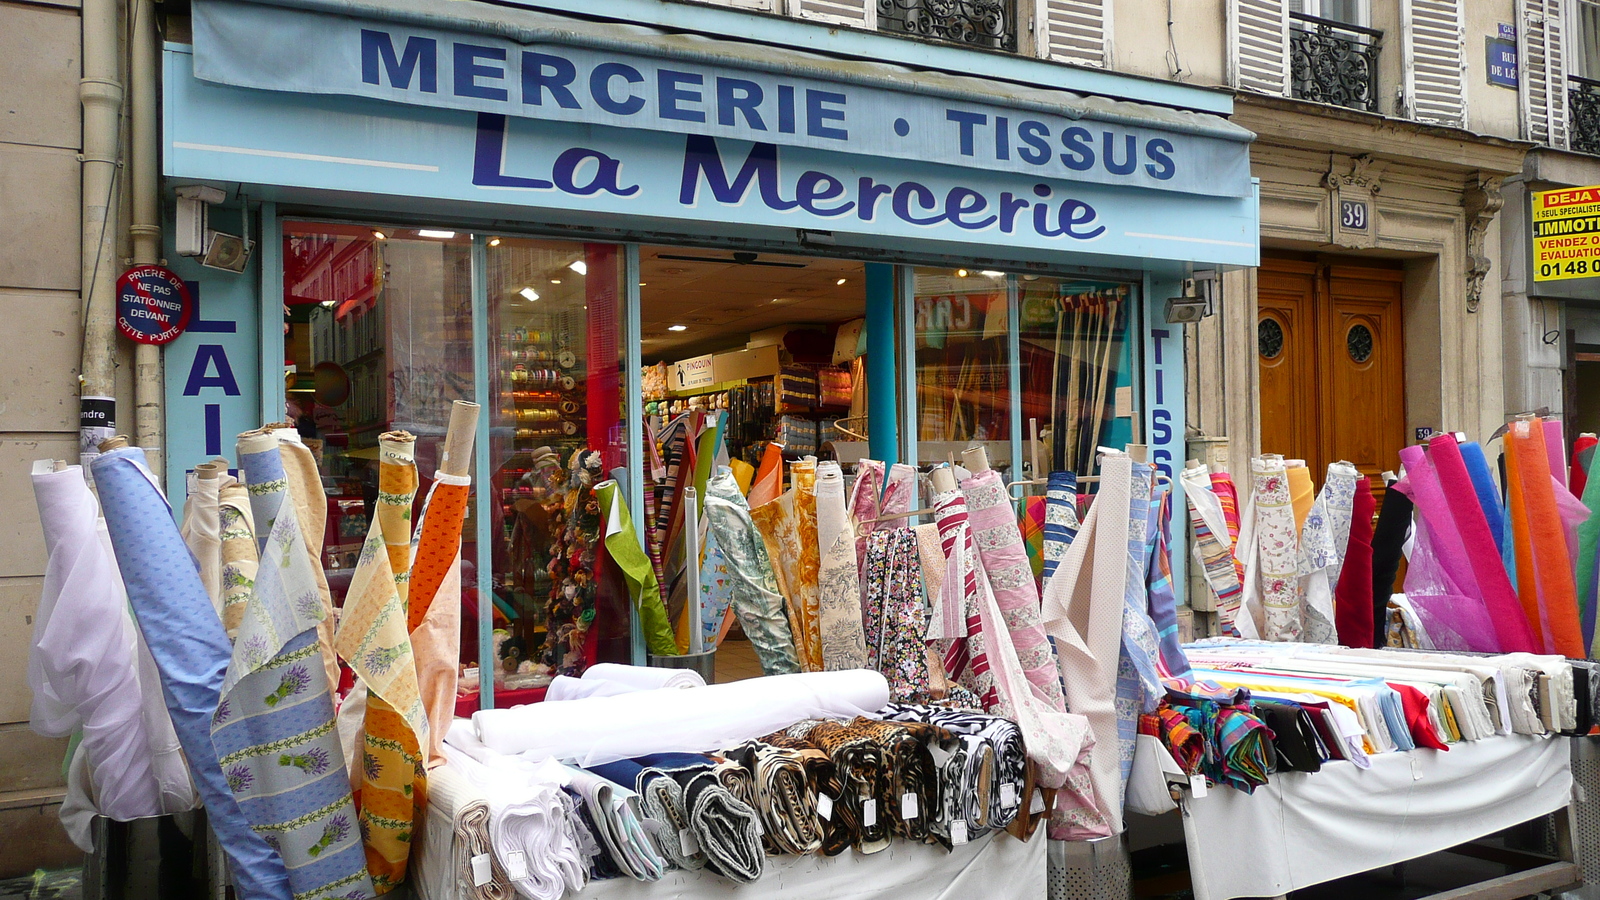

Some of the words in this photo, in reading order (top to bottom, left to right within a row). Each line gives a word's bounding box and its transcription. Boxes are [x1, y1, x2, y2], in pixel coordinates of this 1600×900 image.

[1491, 64, 1502, 77] DE
[1505, 67, 1517, 80] LÉ
[361, 29, 849, 142] MERCERIE
[946, 108, 1177, 182] TISSUS
[472, 112, 640, 197] La
[679, 134, 1107, 240] Mercerie
[1548, 191, 1593, 205] DEJA
[1343, 202, 1364, 227] 39
[1542, 208, 1558, 218] SEUL
[1540, 236, 1588, 249] VENDEZ
[1541, 247, 1600, 260] EVALUATIO
[1541, 262, 1560, 277] 01
[1565, 260, 1587, 274] 48
[127, 269, 166, 282] PRIERE
[169, 277, 183, 291] DE
[137, 282, 151, 292] NE
[153, 285, 171, 296] PAS
[122, 294, 181, 312] STATIONNER
[130, 308, 171, 323] DEVANT
[118, 316, 144, 339] CETTE
[150, 325, 179, 341] PORTE
[183, 281, 241, 500] LAI
[1151, 329, 1173, 541] TISS
[1417, 428, 1430, 439] 39
